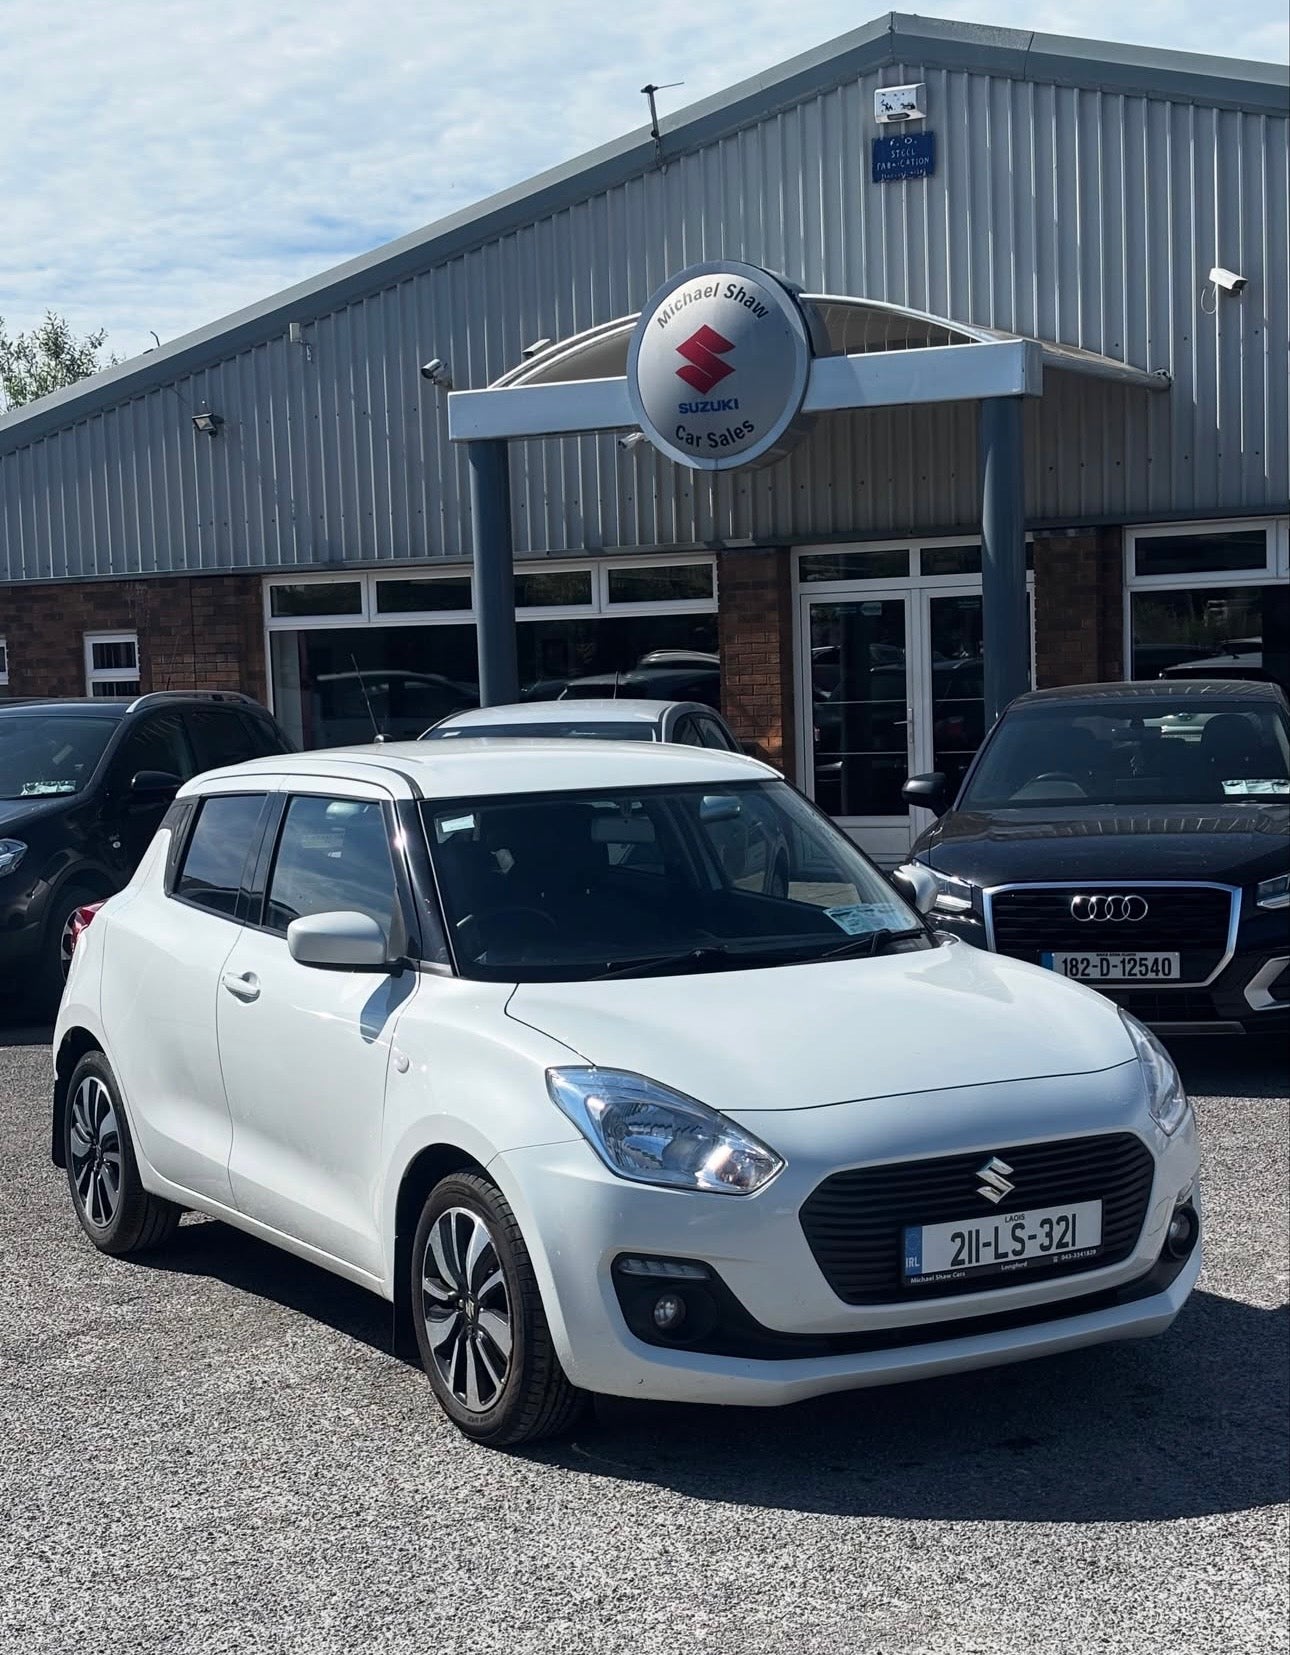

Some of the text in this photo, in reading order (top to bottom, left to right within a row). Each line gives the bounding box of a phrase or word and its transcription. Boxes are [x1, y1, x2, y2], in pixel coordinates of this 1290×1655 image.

[656, 282, 770, 329] Michael Shaw
[678, 398, 740, 414] SUZUKI
[675, 419, 755, 449] Car Sales
[1062, 957, 1173, 977] 182-D-12540
[1004, 1213, 1026, 1224] LAOIS
[950, 1213, 1077, 1268] 211-LS-321
[905, 1257, 921, 1269] IRL
[910, 1275, 935, 1284] Michael
[935, 1273, 951, 1281] Shaw
